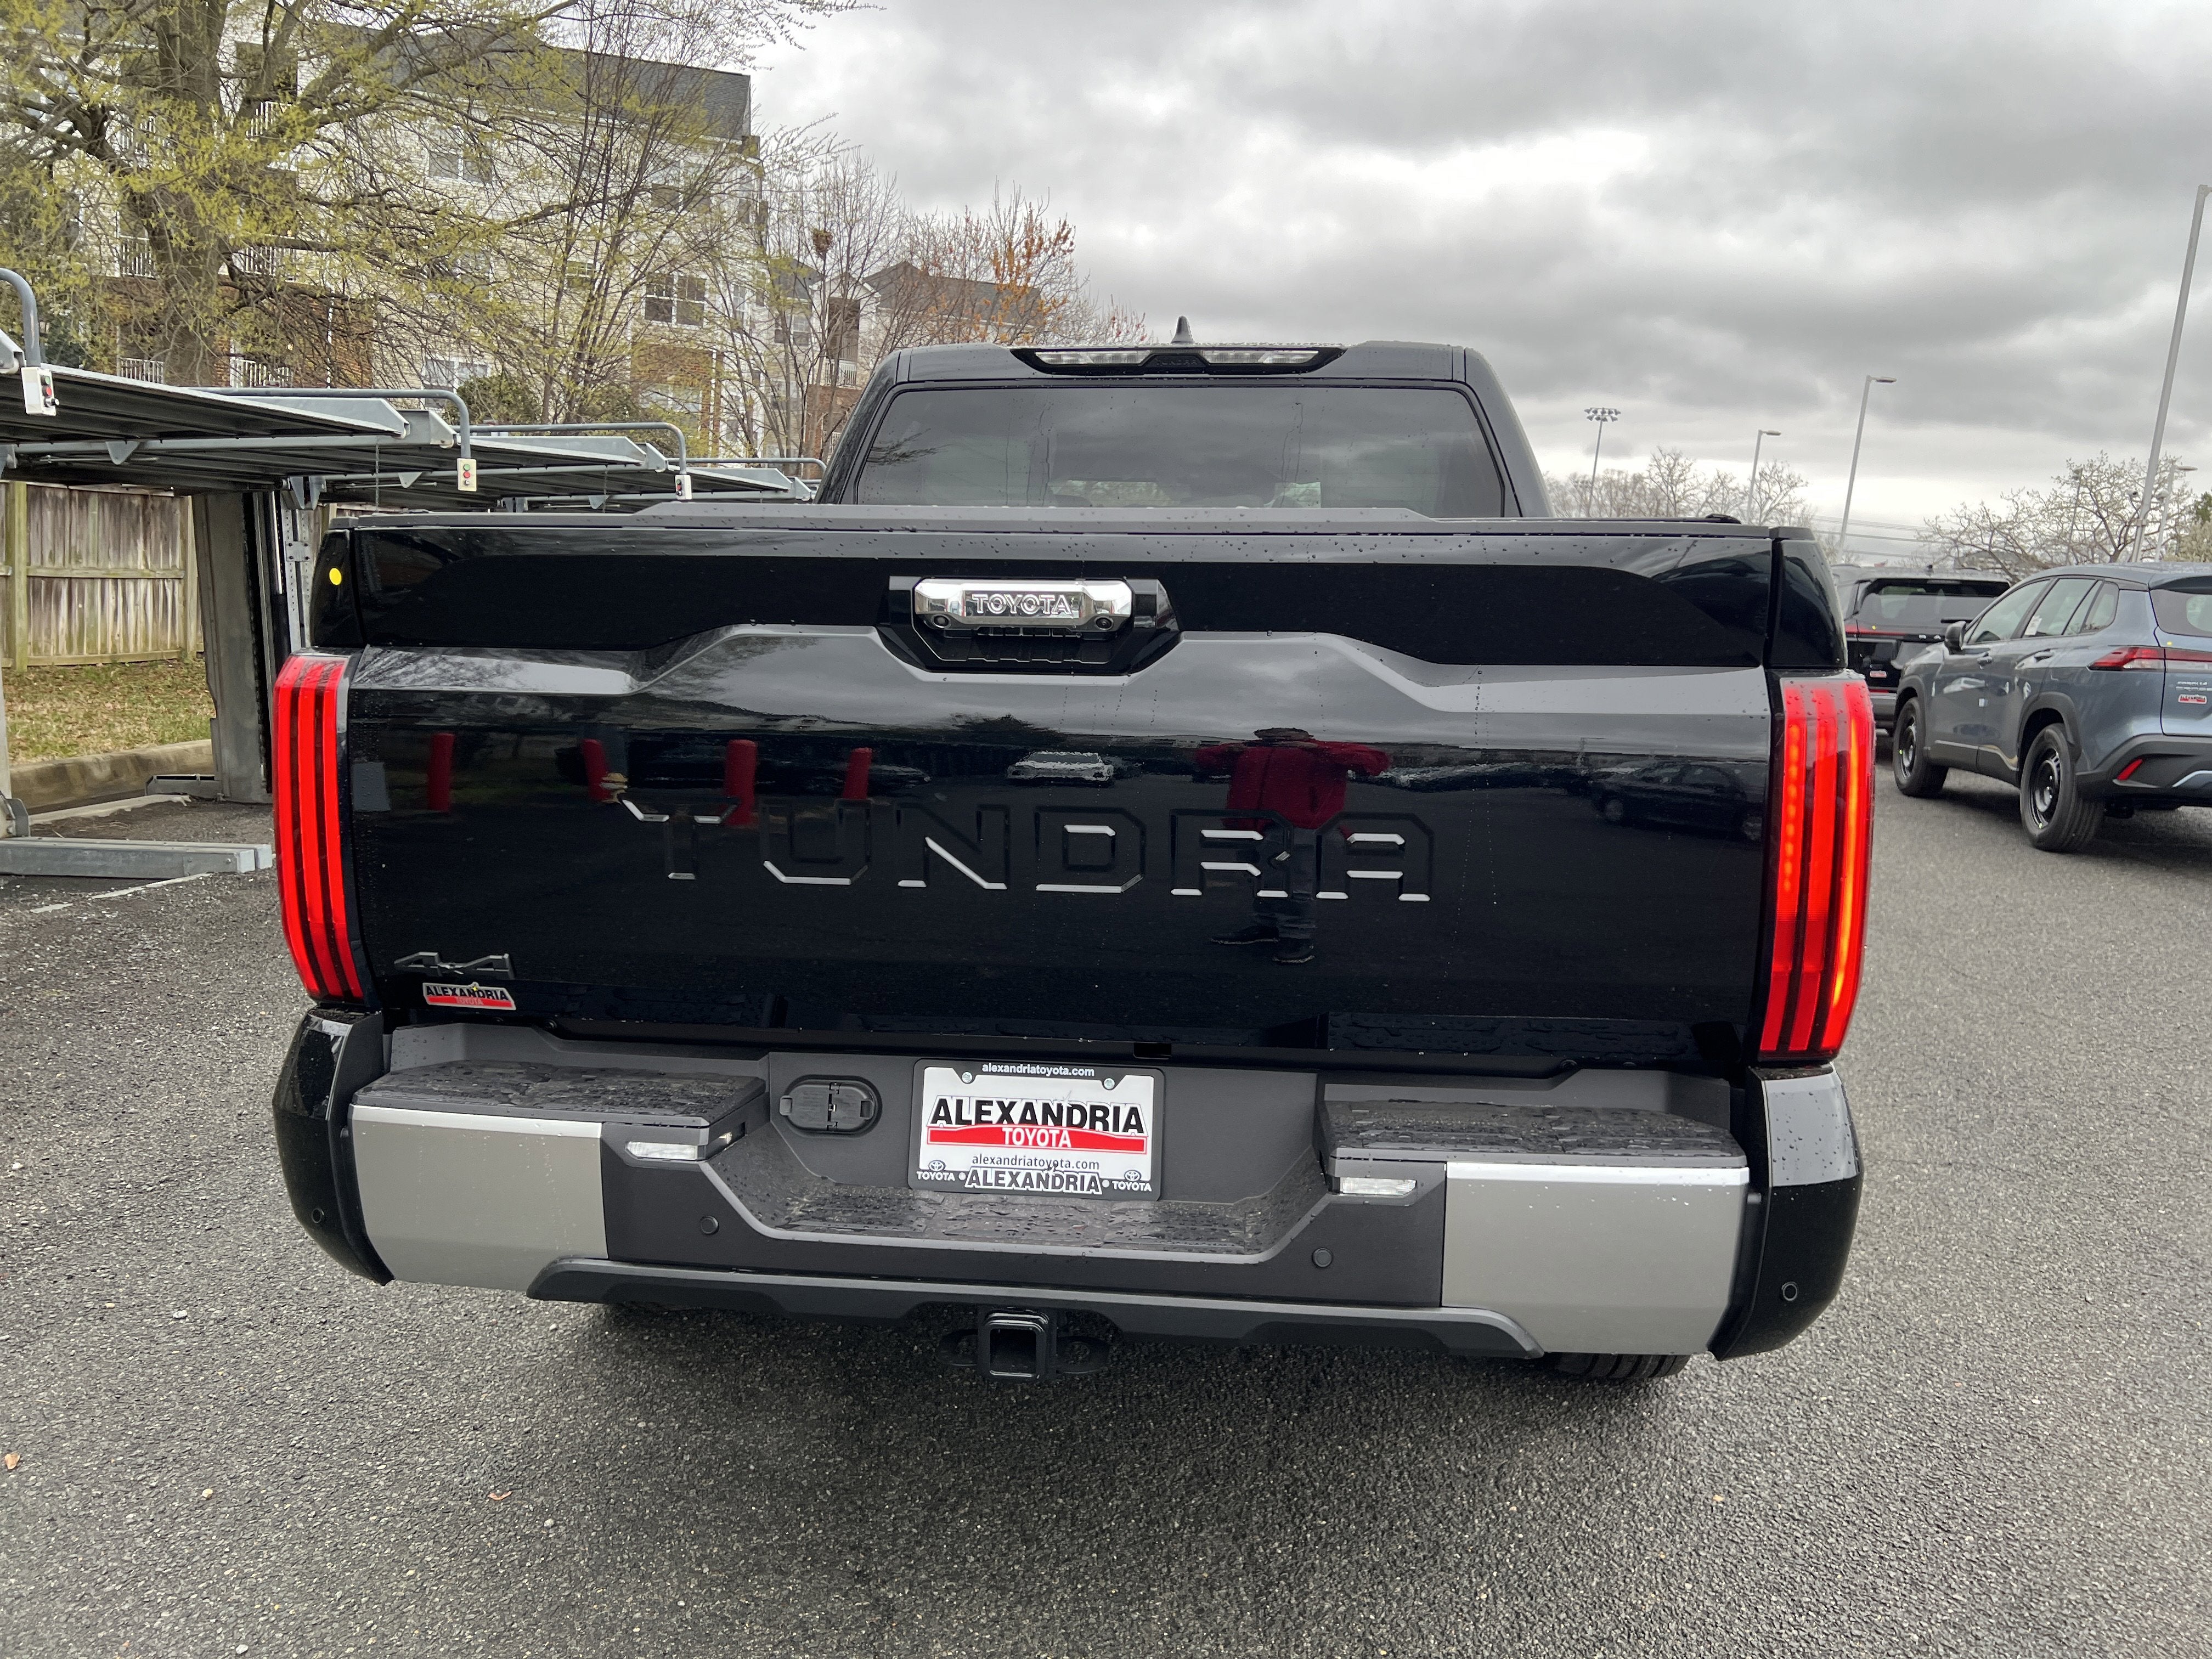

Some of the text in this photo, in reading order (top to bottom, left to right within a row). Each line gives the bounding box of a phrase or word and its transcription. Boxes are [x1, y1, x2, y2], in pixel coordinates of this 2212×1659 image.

[972, 594, 1071, 614] TOYOTA
[619, 795, 1435, 902] TUNDRA
[426, 986, 509, 1001] ALEXANDRIA
[456, 997, 484, 1006] TOYOTA
[982, 1063, 1094, 1077] alexandriatoyota.com
[930, 1098, 1145, 1133] ALEXANDRIA
[1002, 1127, 1071, 1148] TOYOTA
[972, 1153, 1099, 1170] alexandriatoyota.com
[916, 1171, 955, 1181] TOYOTA
[970, 1169, 1101, 1193] ALEXANDRIA
[1112, 1180, 1152, 1192] TOYOTA
